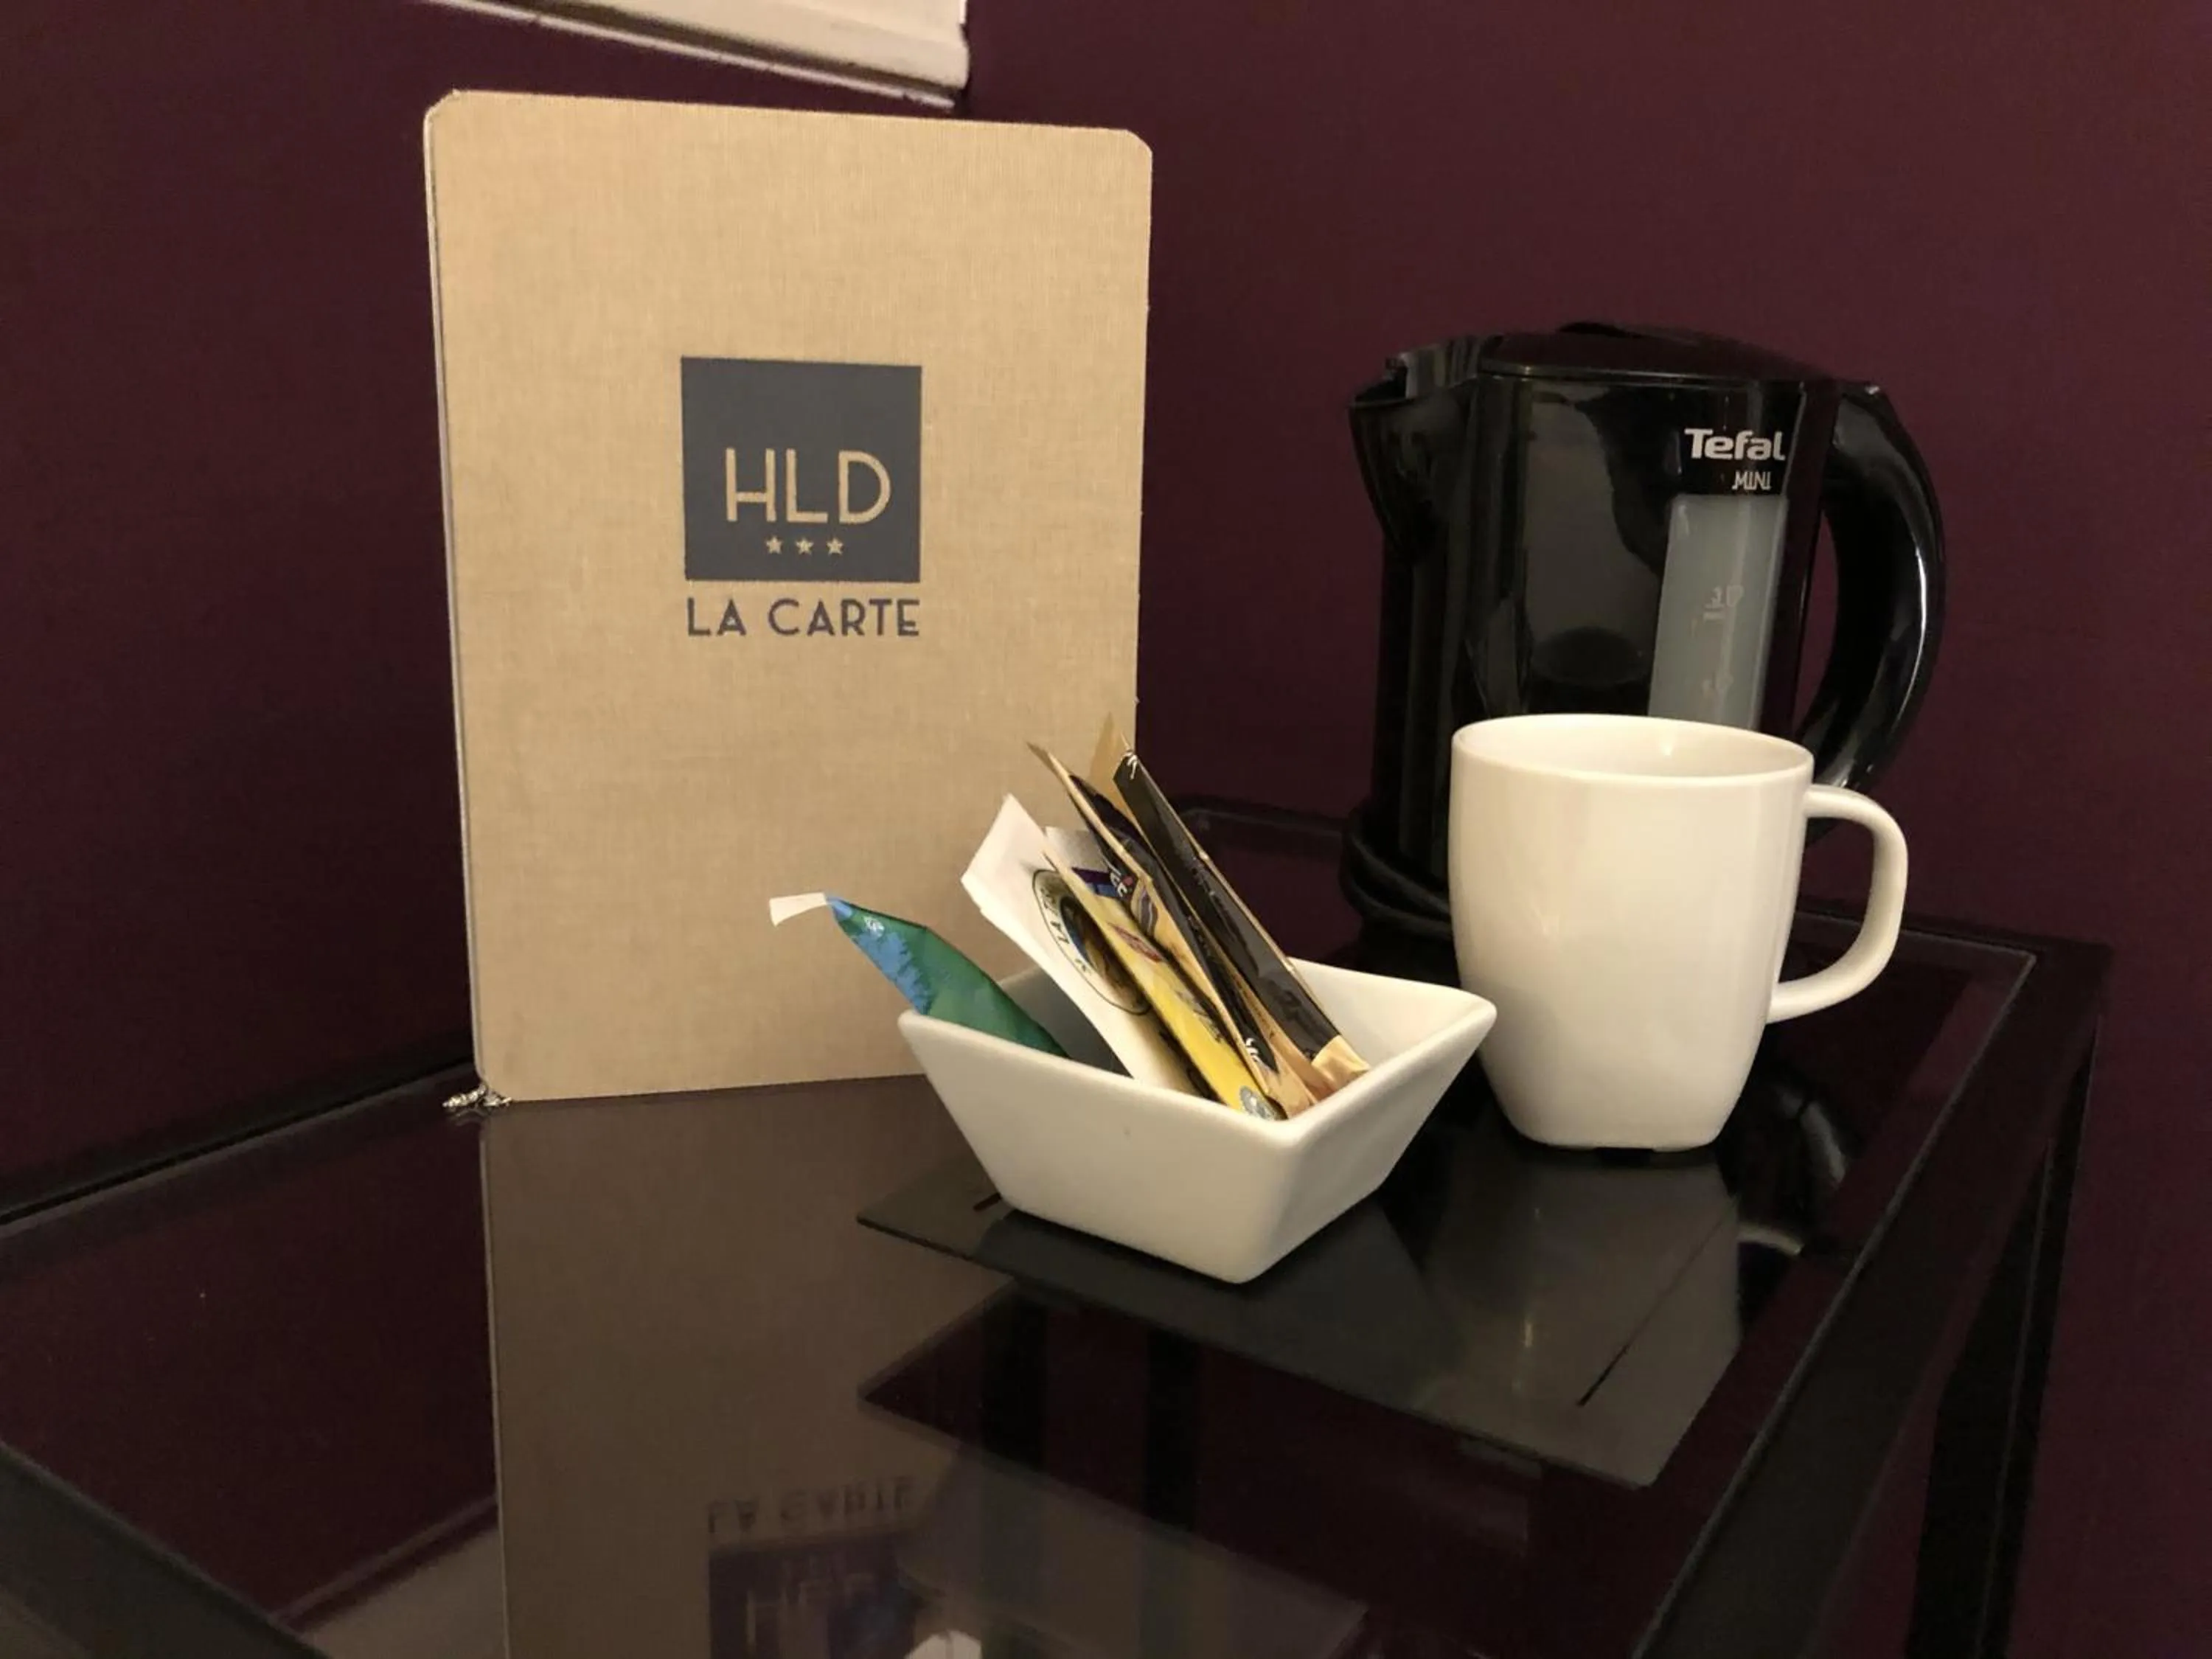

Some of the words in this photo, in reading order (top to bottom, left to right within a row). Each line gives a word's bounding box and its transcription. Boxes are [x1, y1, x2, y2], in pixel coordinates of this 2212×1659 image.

[1684, 428, 1786, 461] Tefal
[725, 448, 891, 524] HLD
[1731, 470, 1772, 490] MINI
[687, 597, 747, 636] LA
[768, 599, 920, 637] CARTE
